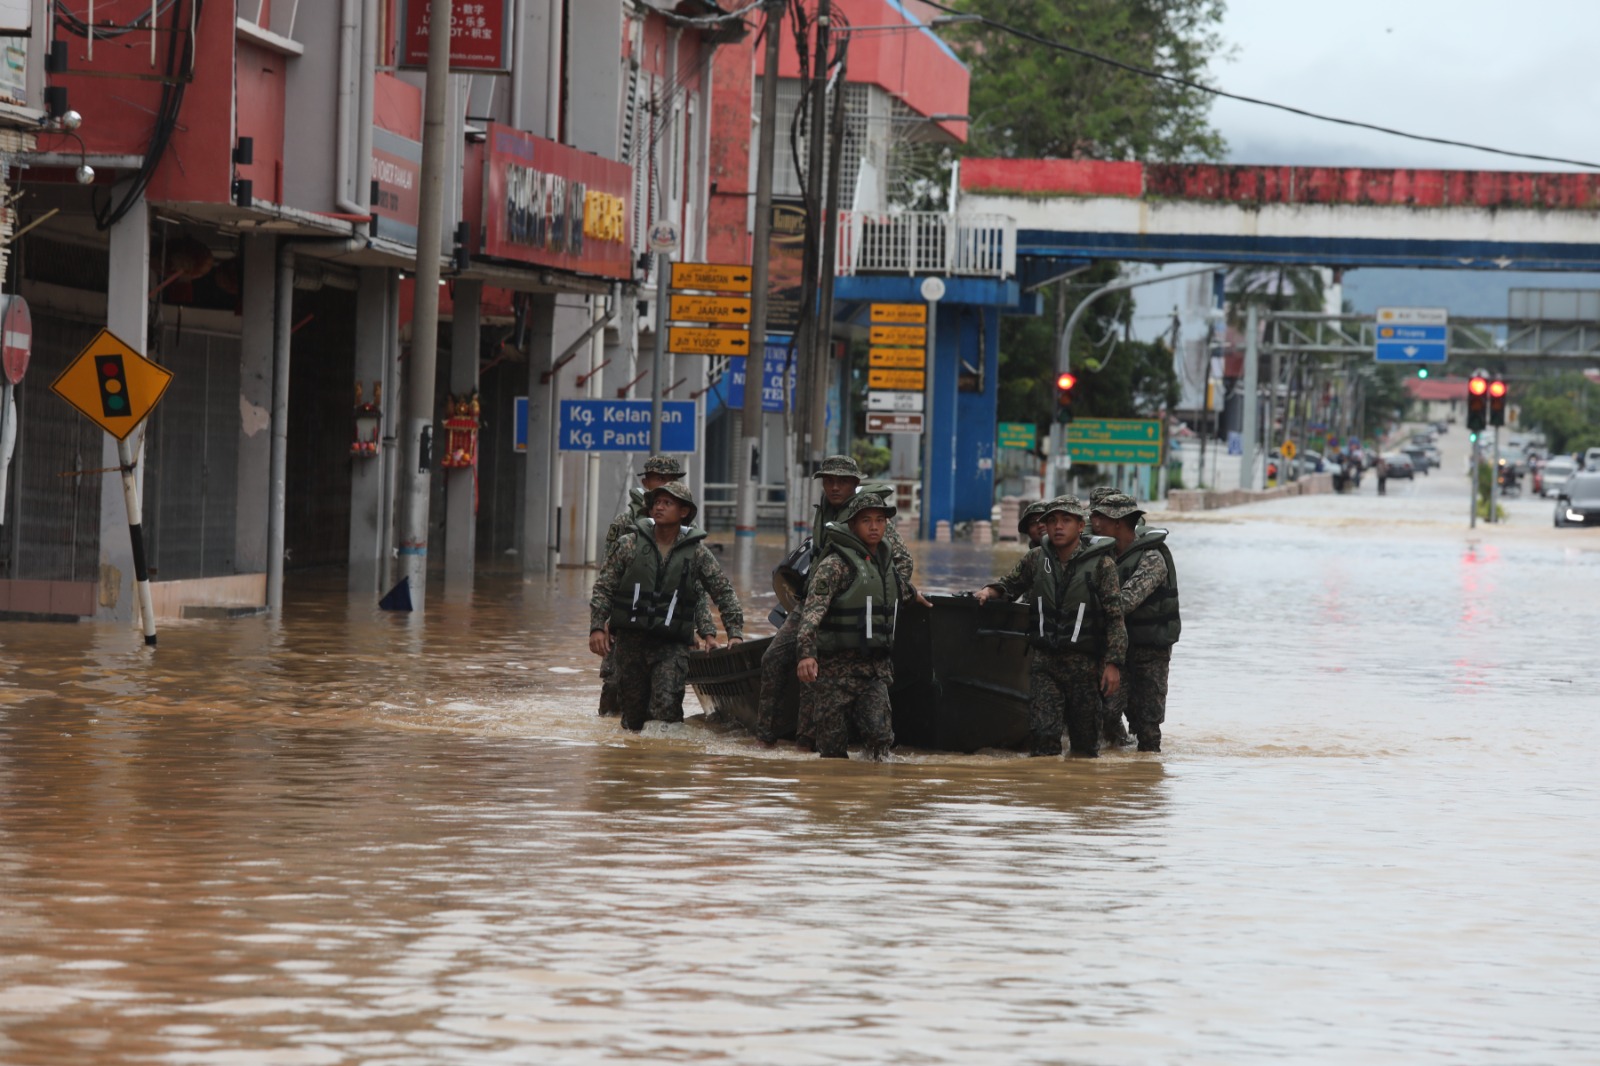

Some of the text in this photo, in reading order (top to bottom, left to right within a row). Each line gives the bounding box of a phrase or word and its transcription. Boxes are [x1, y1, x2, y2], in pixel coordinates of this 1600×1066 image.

[416, 26, 463, 36] JAOT
[697, 306, 729, 316] JAAFAR
[693, 338, 721, 348] YUSOF
[569, 406, 682, 426] Kg. Kelanan
[569, 429, 650, 449] Kg. Panti
